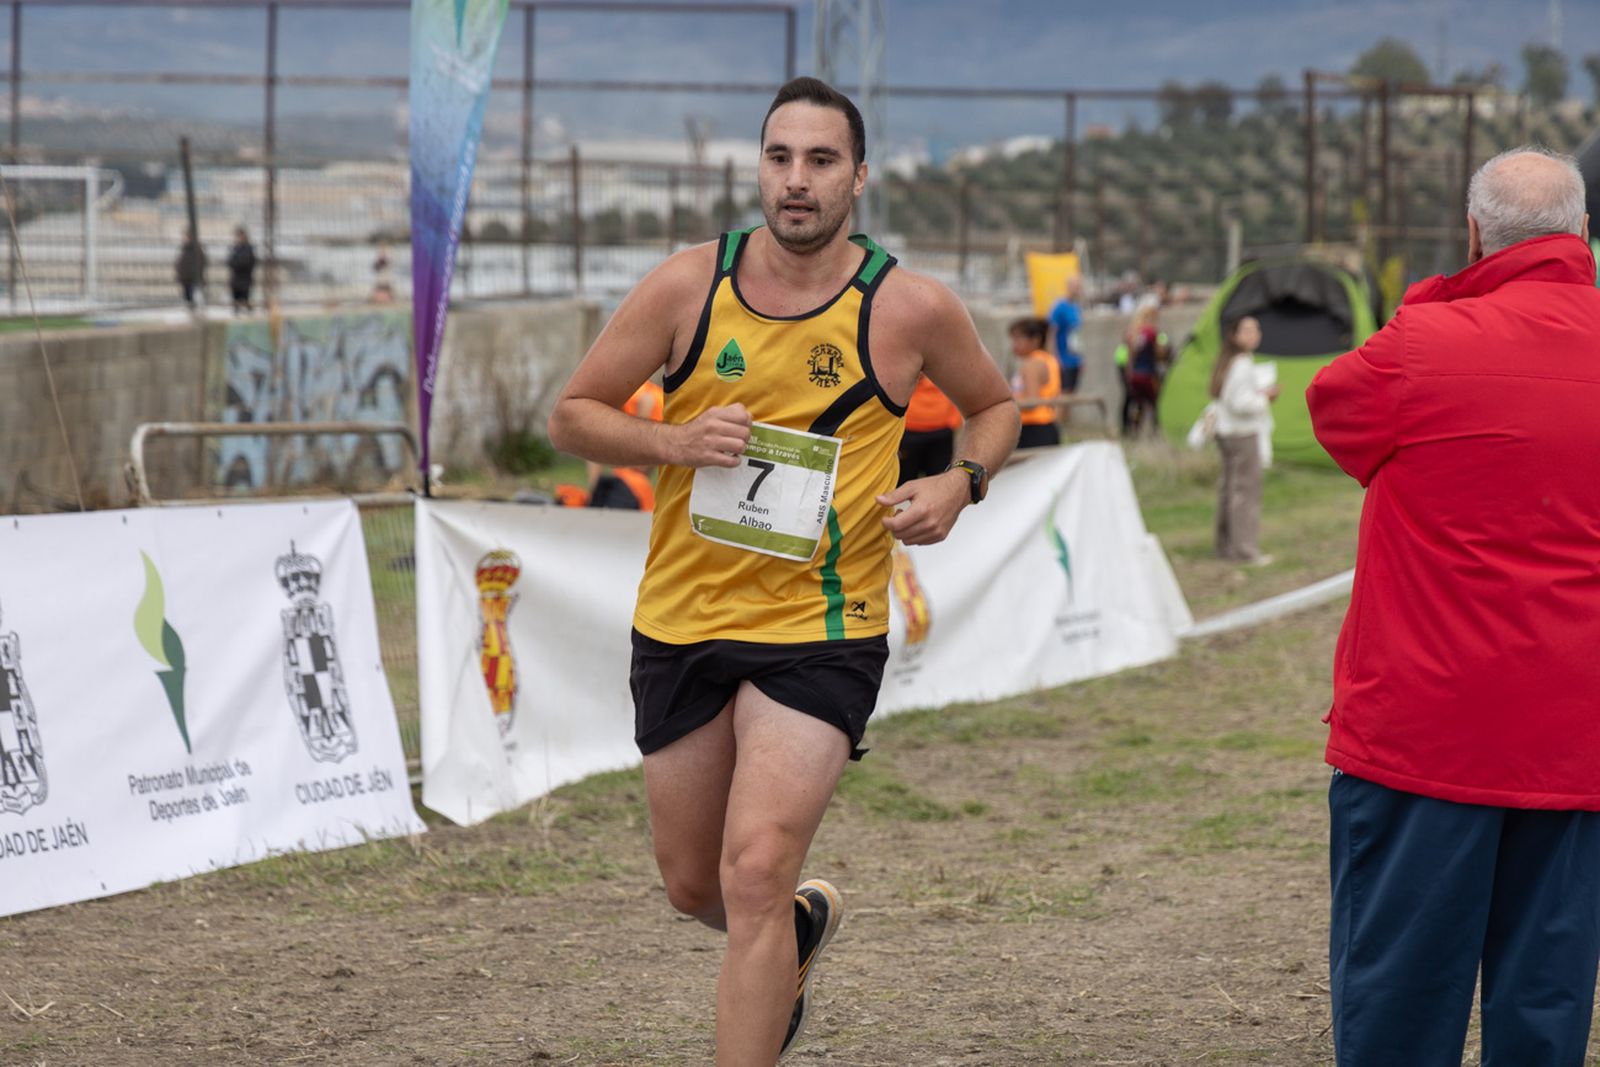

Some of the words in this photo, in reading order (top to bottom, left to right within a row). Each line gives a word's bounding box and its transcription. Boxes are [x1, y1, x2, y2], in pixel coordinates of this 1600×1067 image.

[717, 352, 744, 369] Jaén
[775, 448, 801, 461] través
[746, 458, 776, 502] 7
[820, 458, 834, 503] Masculino
[737, 500, 770, 516] Ruben
[816, 505, 827, 525] ABS
[739, 515, 773, 532] Albao
[127, 769, 185, 795] Patronato
[344, 773, 366, 796] DE
[149, 797, 202, 824] Deportes
[218, 785, 251, 806] Jaén
[26, 828, 50, 854] DE
[52, 817, 89, 850] JAÉN
